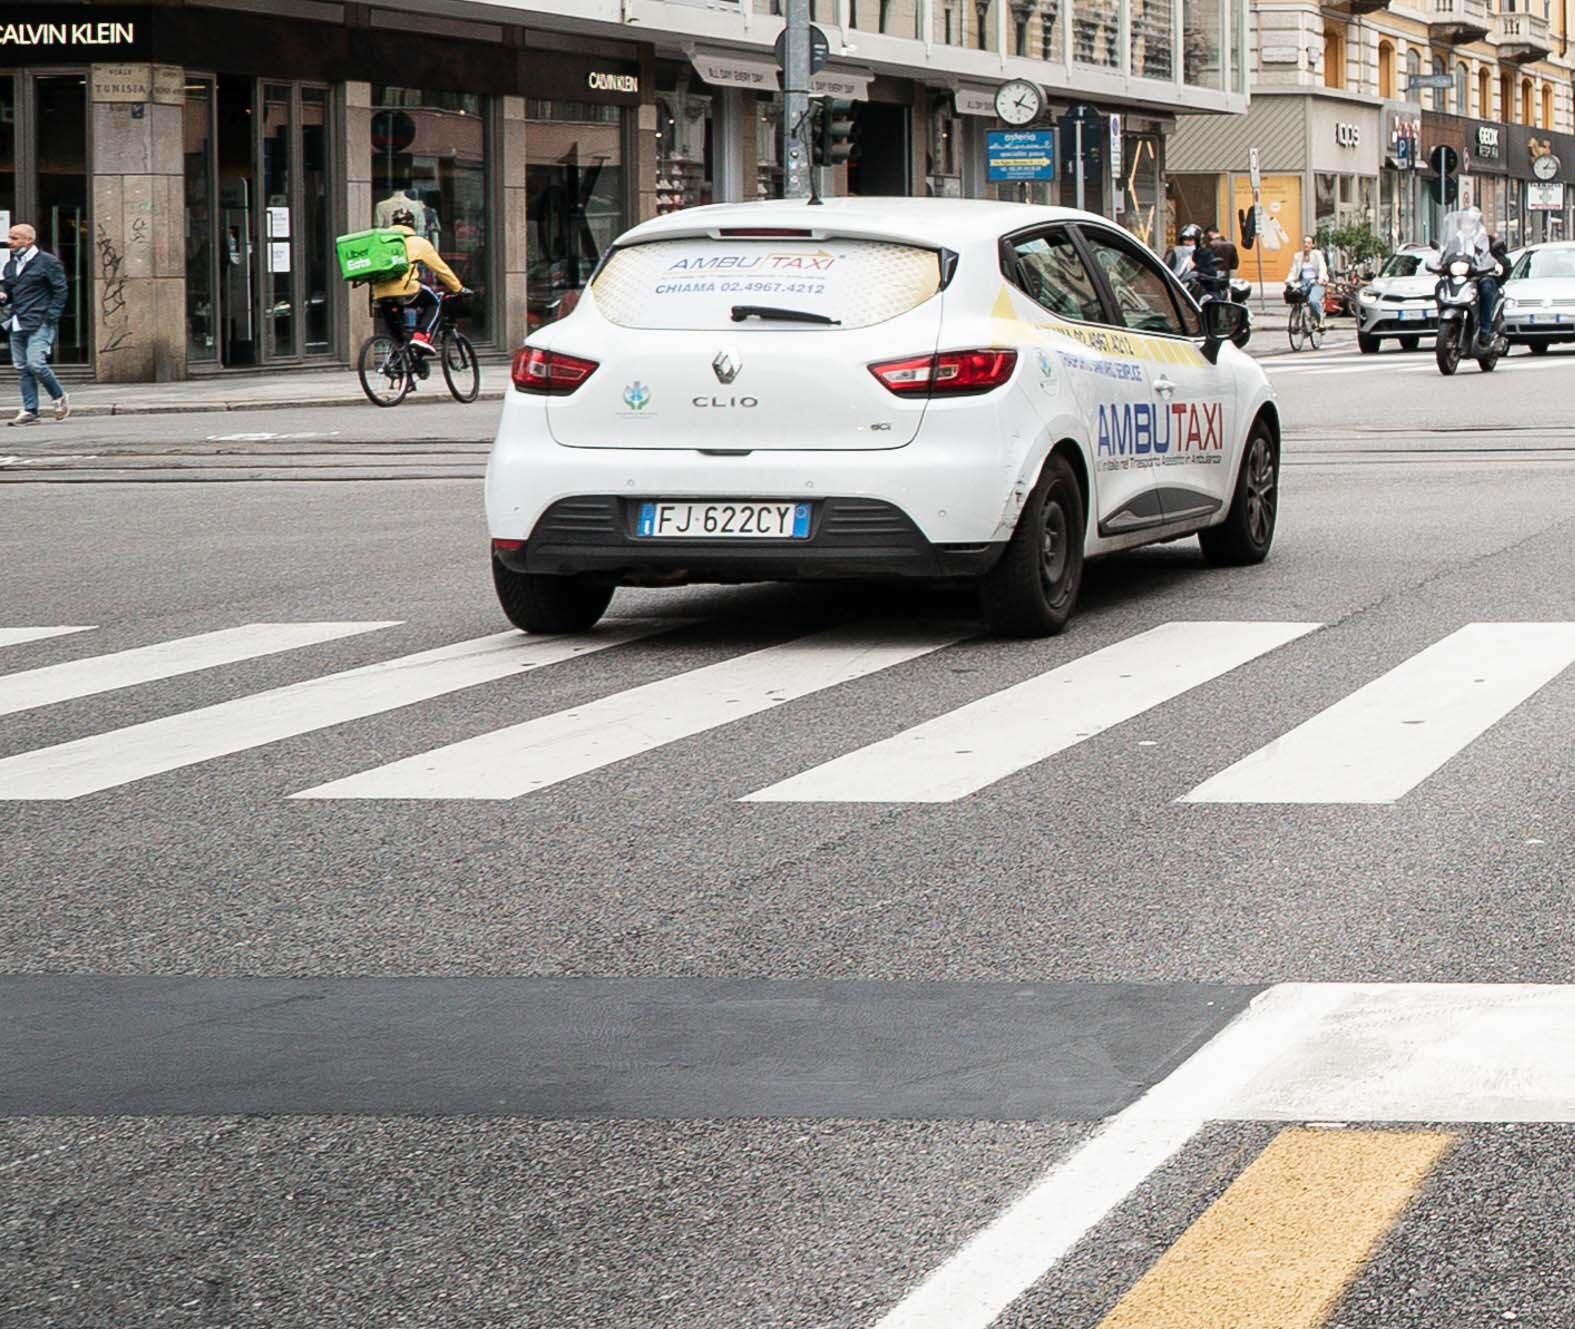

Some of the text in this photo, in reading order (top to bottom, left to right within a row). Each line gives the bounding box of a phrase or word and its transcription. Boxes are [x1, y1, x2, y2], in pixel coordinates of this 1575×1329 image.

[0, 22, 134, 45] ALVIN KLEIN
[95, 84, 146, 93] TUNISIA
[1478, 126, 1499, 146] GEOX
[670, 256, 834, 270] AMBU TAXI
[655, 281, 825, 295] CHIAMA 02.4967.4212
[692, 396, 758, 408] CLIO
[658, 506, 791, 534] FJ 622CY
